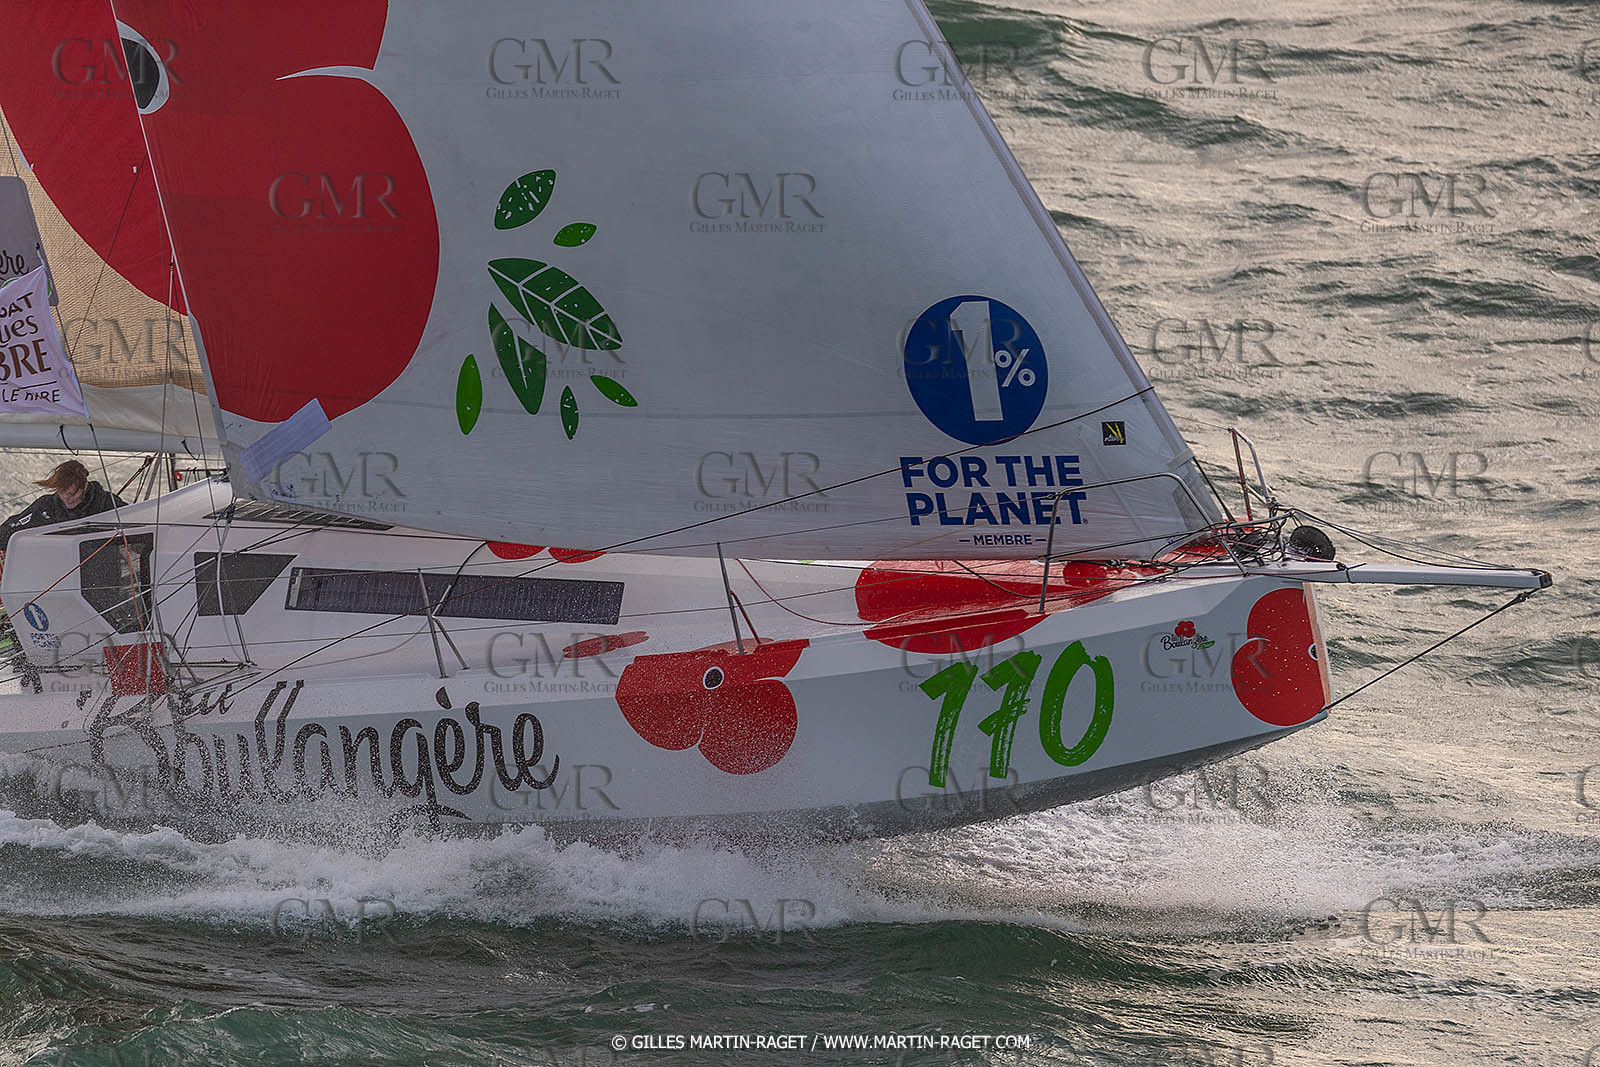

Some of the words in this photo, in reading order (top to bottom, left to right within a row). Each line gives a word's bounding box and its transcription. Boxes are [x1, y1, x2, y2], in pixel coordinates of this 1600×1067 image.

[950, 300, 1036, 422] 1%
[900, 456, 991, 488] FOR
[995, 455, 1083, 487] THE
[973, 534, 1032, 546] MEMBRE
[918, 640, 1115, 788] 170
